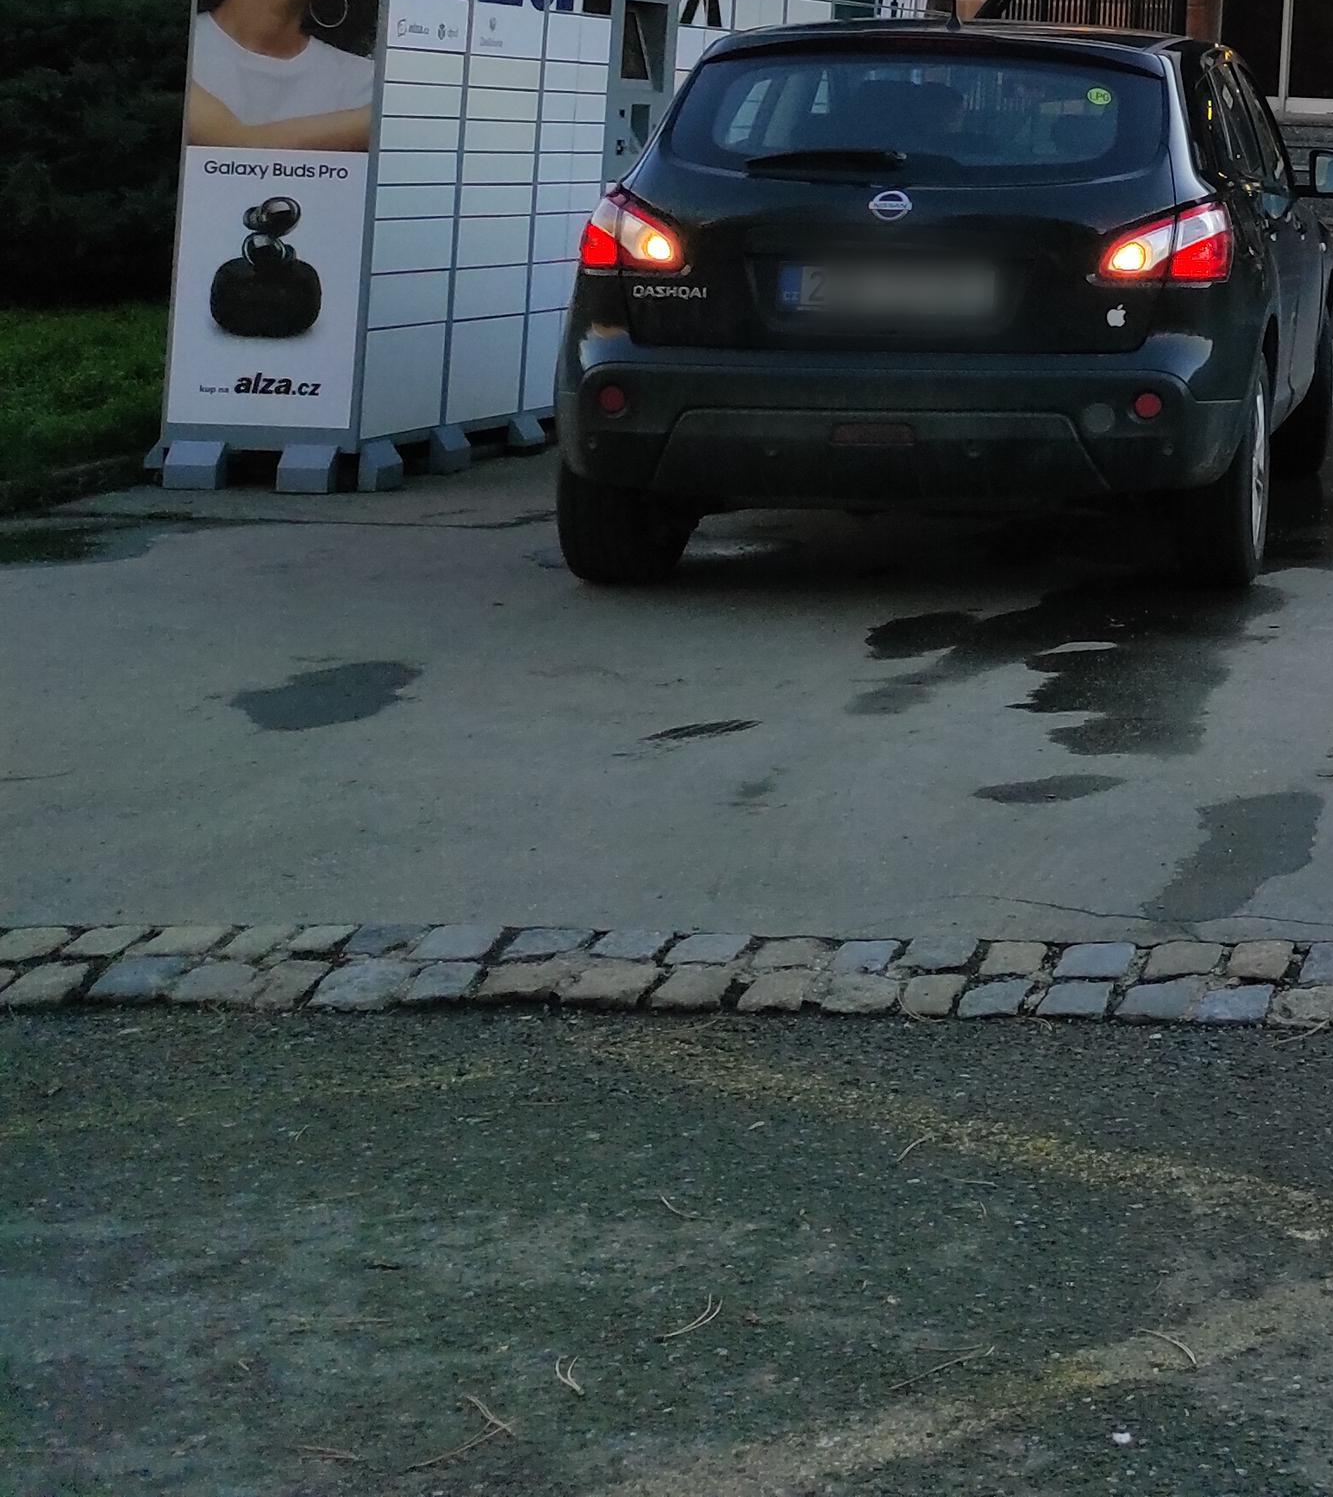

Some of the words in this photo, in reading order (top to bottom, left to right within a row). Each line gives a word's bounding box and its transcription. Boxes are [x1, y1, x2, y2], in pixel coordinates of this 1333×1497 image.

[1089, 91, 1110, 102] LPG
[204, 160, 269, 180] Galaxy
[272, 162, 315, 179] Buds
[319, 164, 349, 179] Pro
[633, 285, 708, 300] QASHQAI
[199, 384, 216, 395] kup
[234, 372, 322, 396] alza.cz
